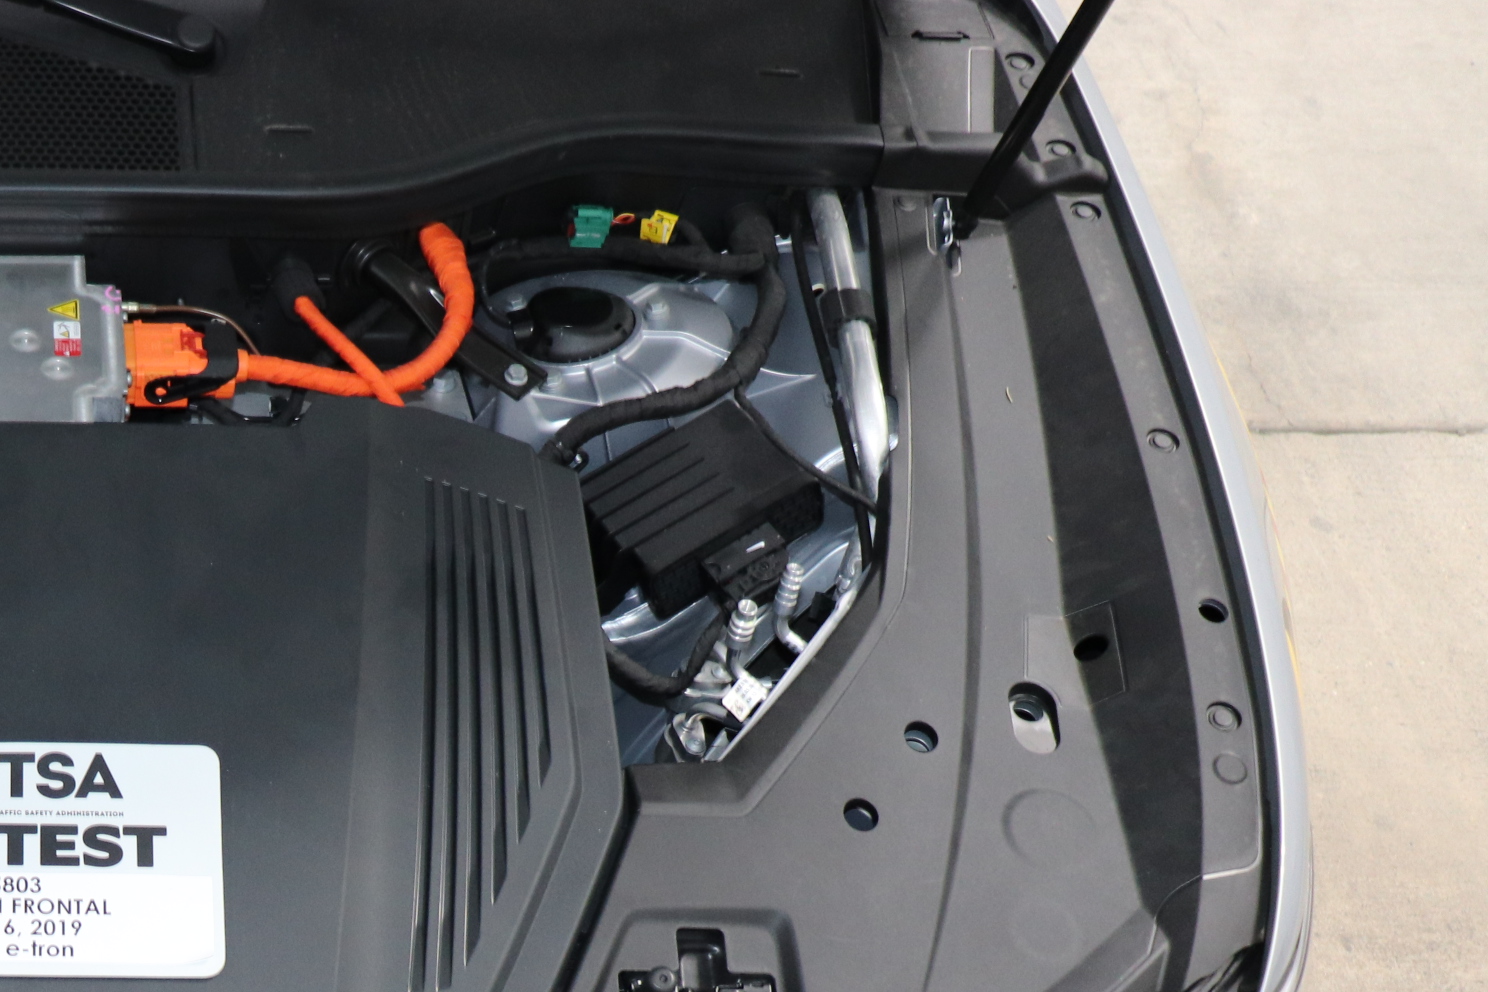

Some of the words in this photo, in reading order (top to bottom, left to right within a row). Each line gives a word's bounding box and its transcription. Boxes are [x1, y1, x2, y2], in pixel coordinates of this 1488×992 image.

[12, 898, 112, 915] FRONTAL
[31, 919, 82, 936] 2019
[6, 941, 74, 957] e-tron
